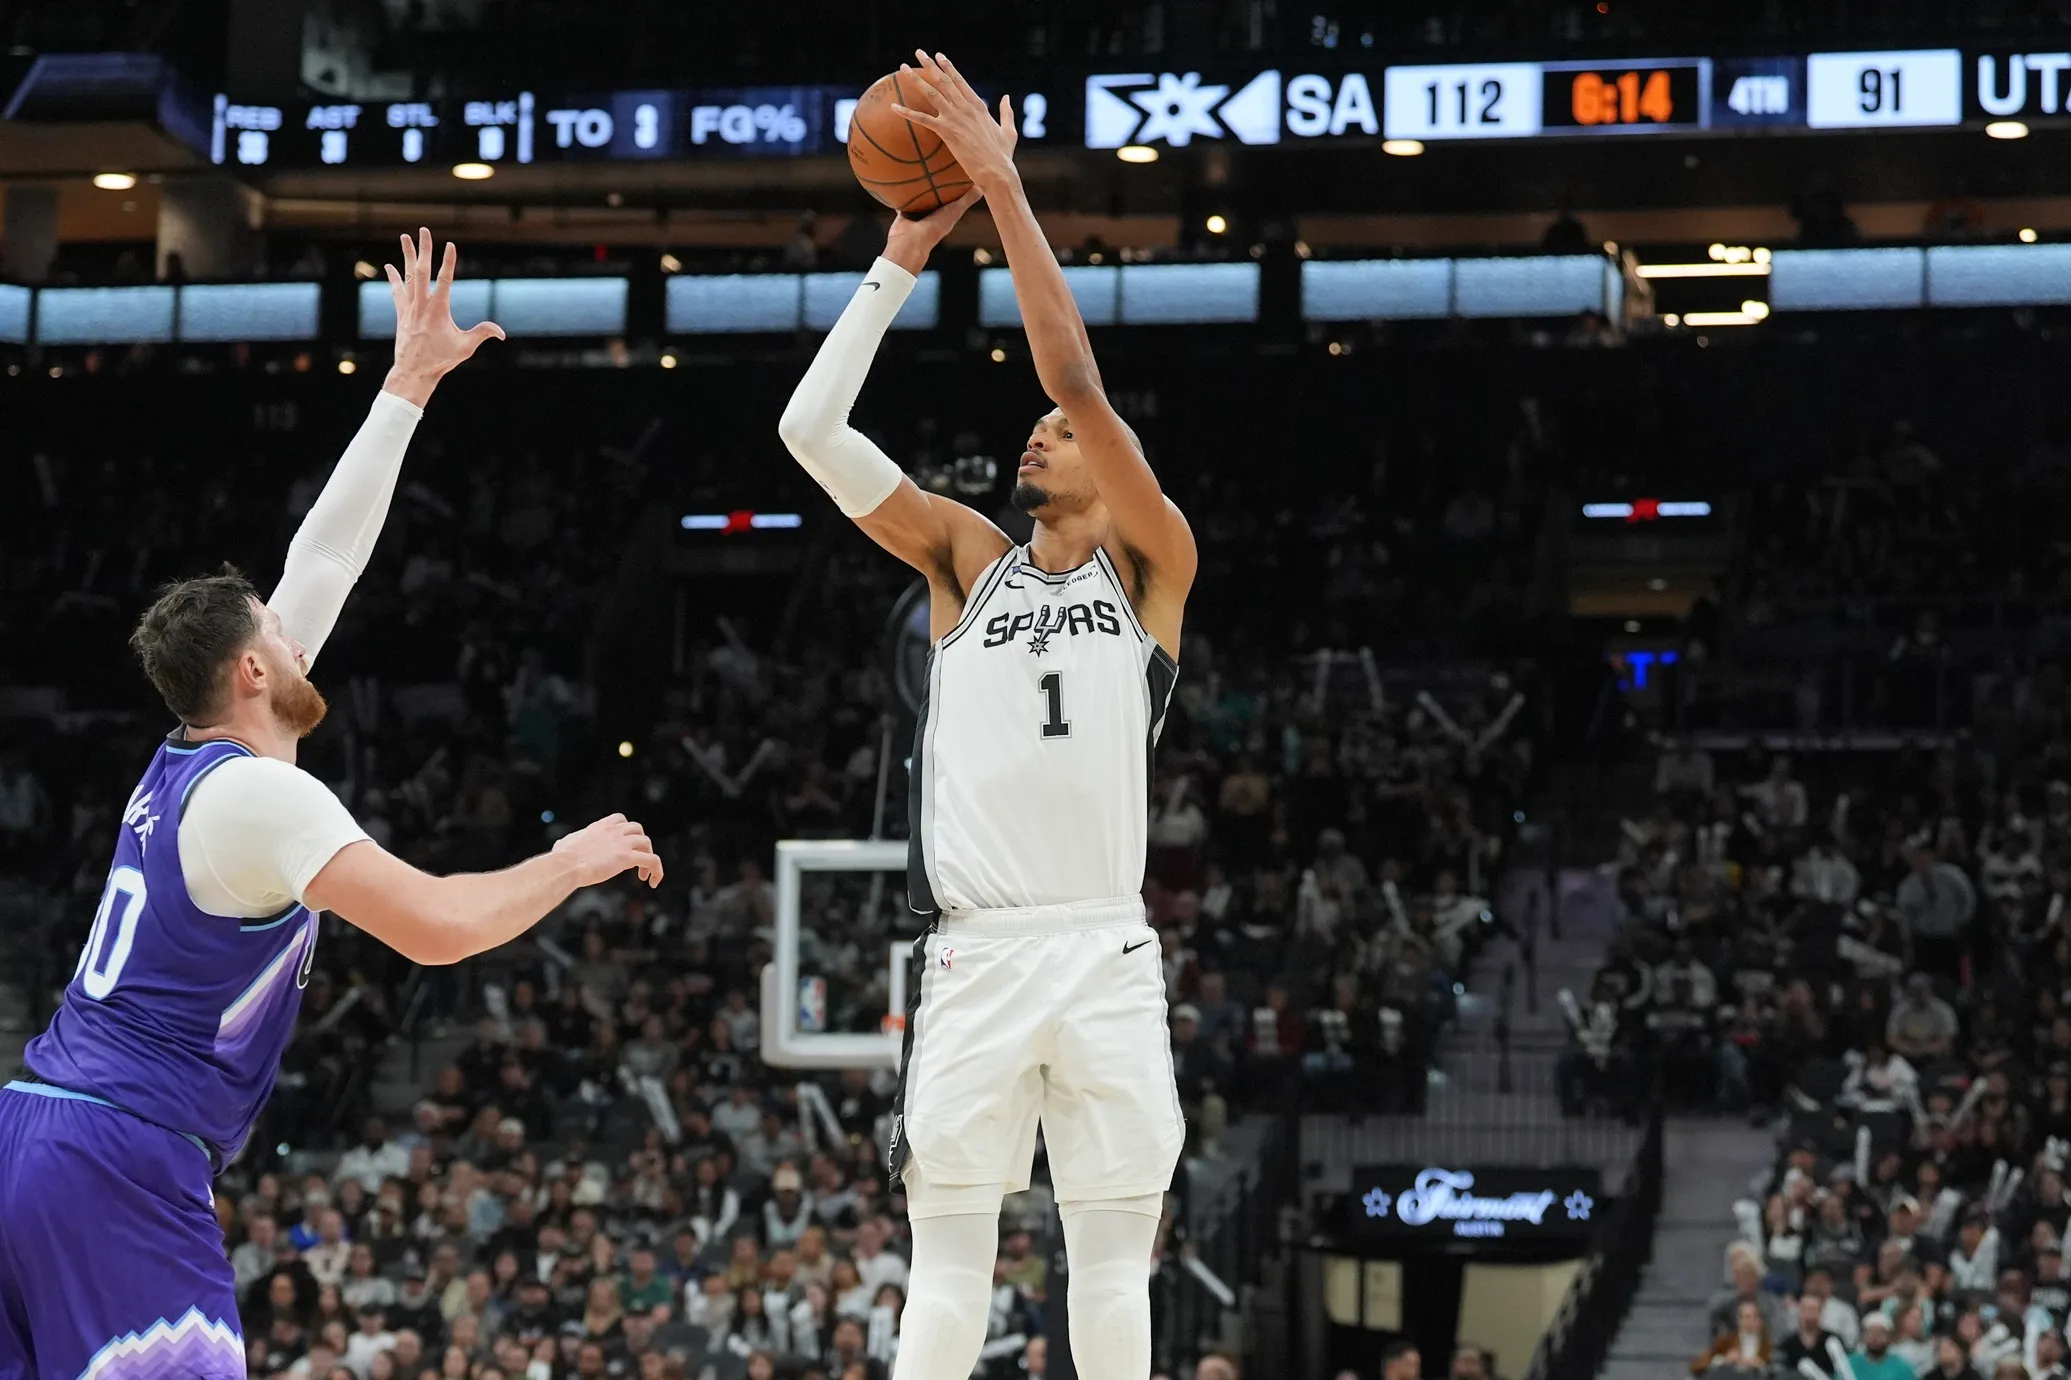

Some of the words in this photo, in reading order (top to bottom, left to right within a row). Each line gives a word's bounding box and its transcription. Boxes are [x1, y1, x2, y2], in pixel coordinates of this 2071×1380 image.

[1286, 73, 1379, 137] SA
[1426, 80, 1504, 126] 112
[1571, 70, 1673, 126] 6:14
[1859, 68, 1901, 113] 91
[1977, 52, 2071, 116] UT
[306, 105, 362, 130] AST
[546, 109, 614, 148] TO
[691, 104, 808, 145] FG%
[983, 599, 1121, 657] SPURS
[1037, 670, 1072, 740] 1
[72, 864, 148, 1001] 0
